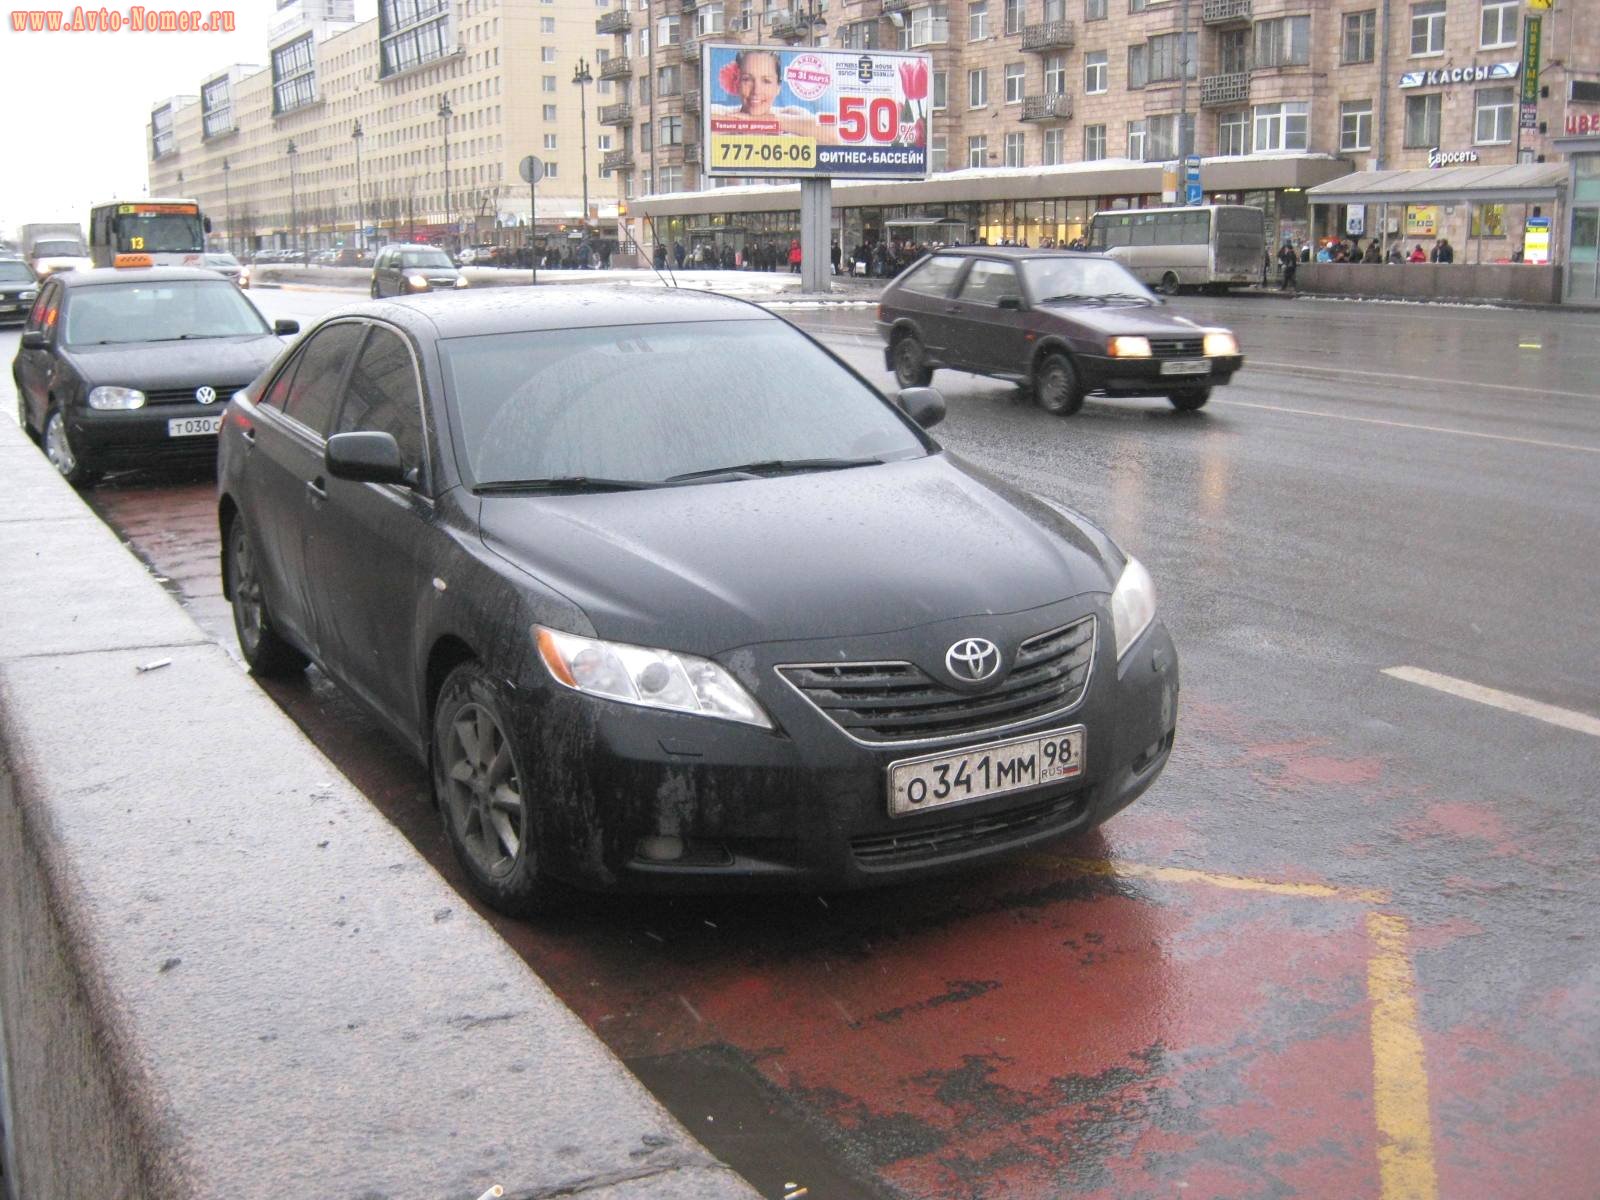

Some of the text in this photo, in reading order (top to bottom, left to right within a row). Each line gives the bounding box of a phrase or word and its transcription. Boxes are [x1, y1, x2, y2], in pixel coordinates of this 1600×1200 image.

[1427, 67, 1489, 85] КАССЫ
[720, 144, 811, 161] 777-06-06
[819, 151, 923, 164] ФИТНЕС+БАССЕЙН
[1428, 147, 1477, 168] Евросеть
[131, 237, 144, 249] 13
[1043, 739, 1072, 767] 98
